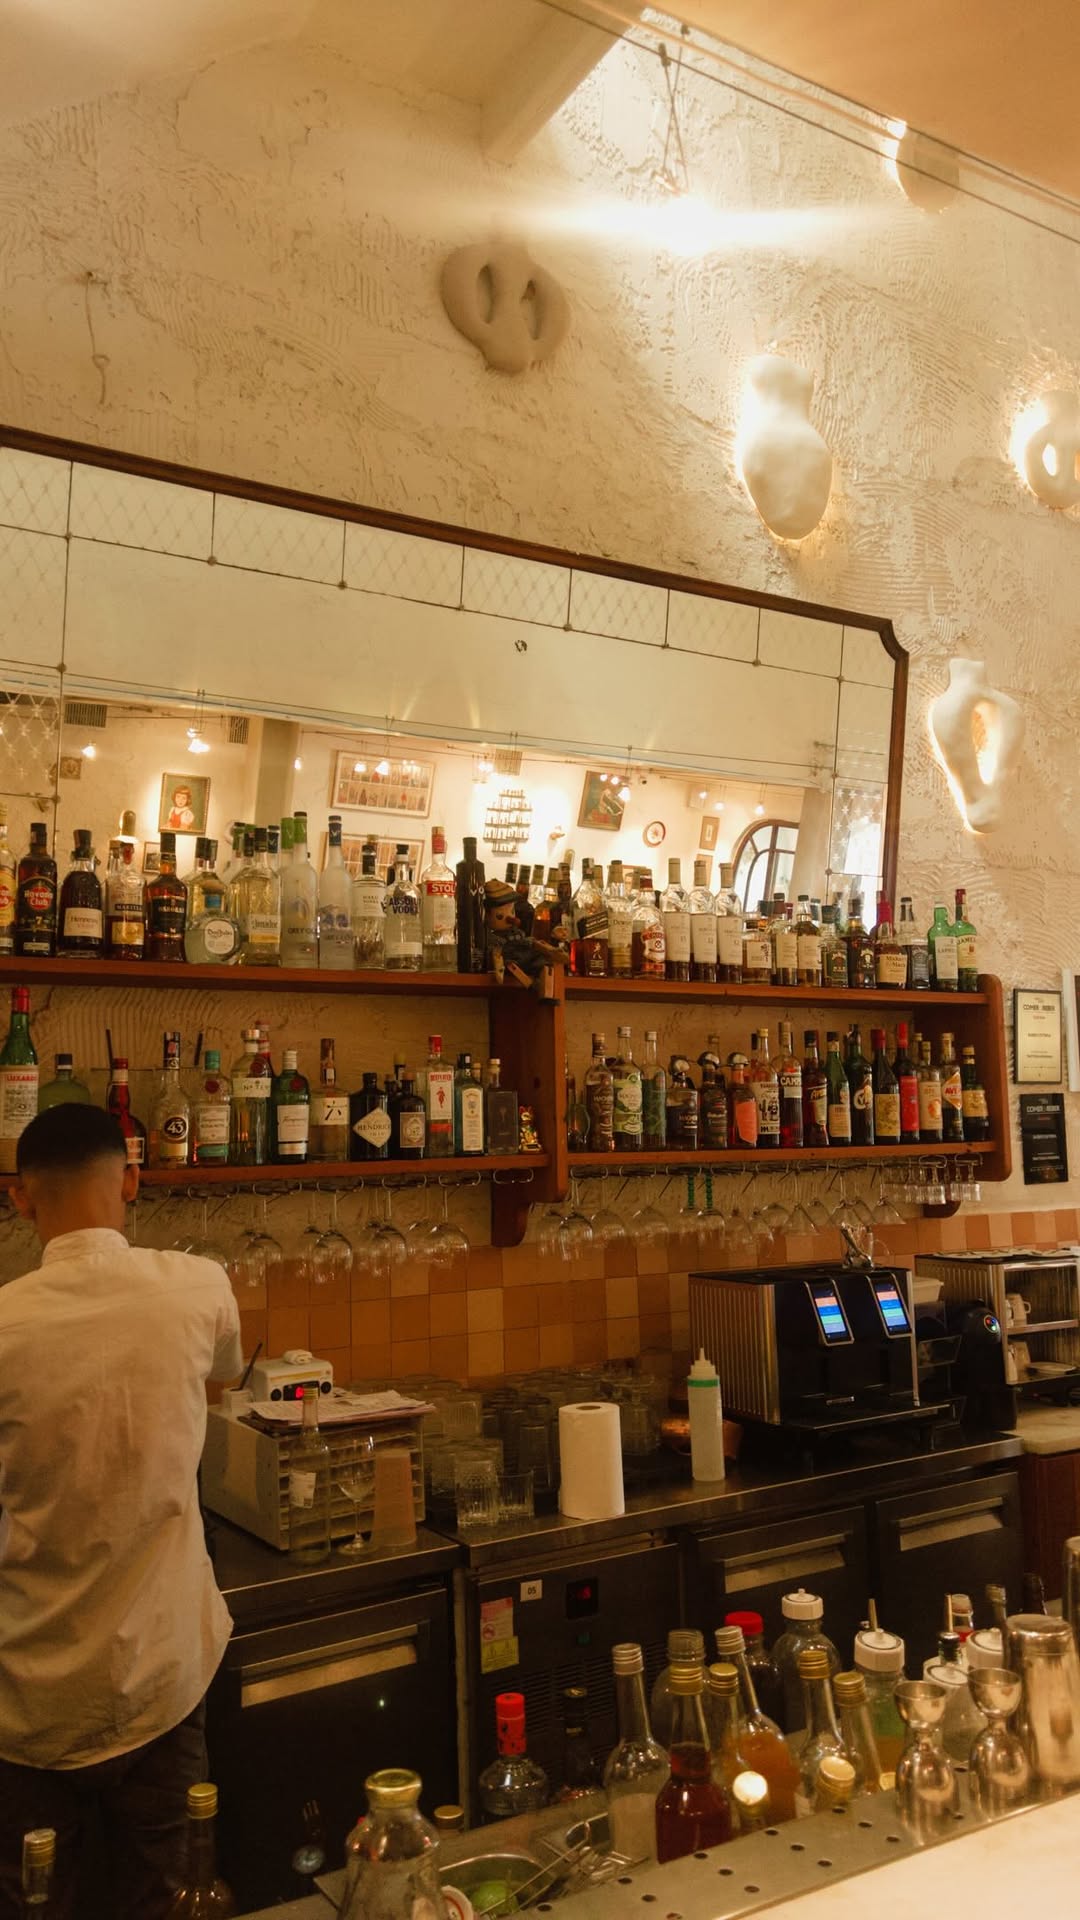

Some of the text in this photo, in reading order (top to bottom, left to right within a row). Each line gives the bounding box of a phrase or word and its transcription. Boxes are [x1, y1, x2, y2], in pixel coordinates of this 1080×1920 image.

[431, 883, 457, 894] STOL
[24, 889, 54, 899] Havana
[30, 898, 49, 906] Club
[35, 916, 43, 925] 7
[780, 1076, 803, 1087] CAMP
[166, 1120, 184, 1135] 43
